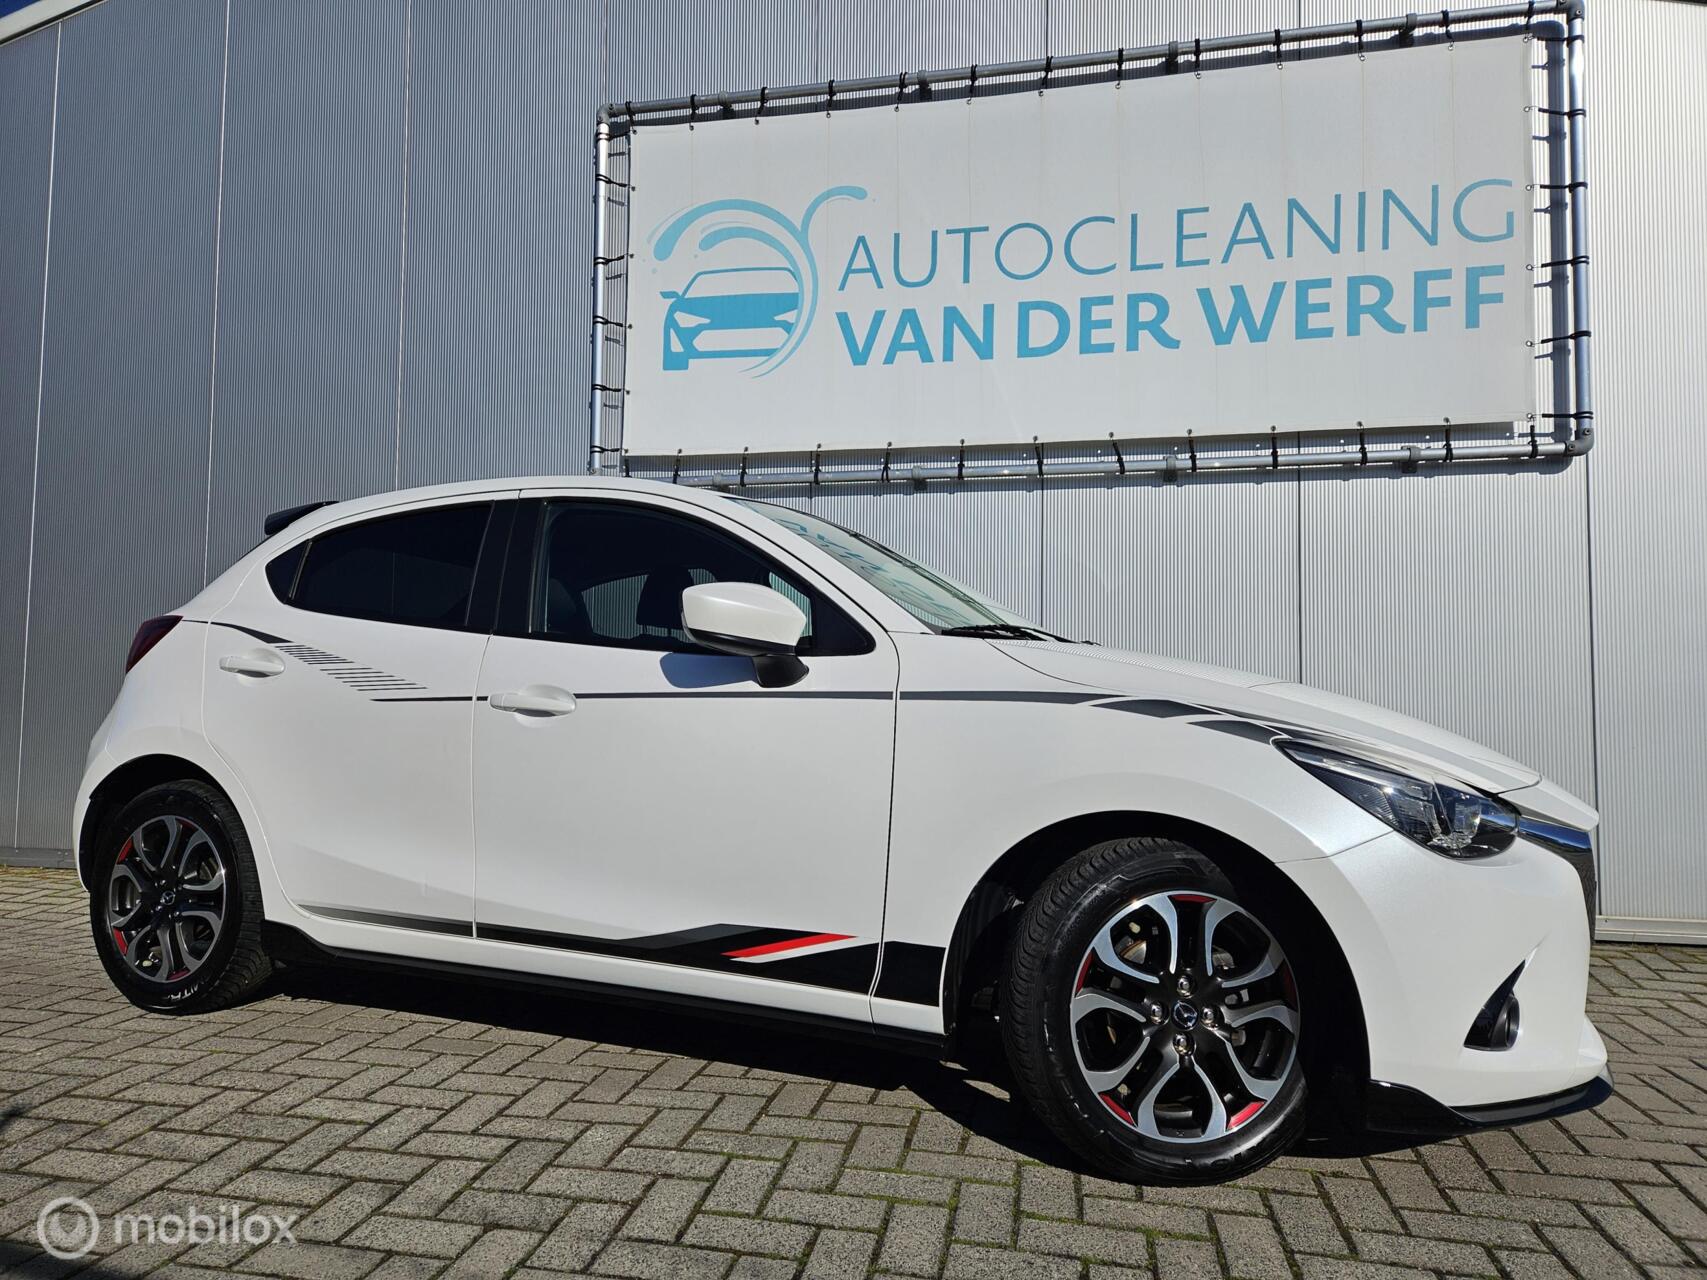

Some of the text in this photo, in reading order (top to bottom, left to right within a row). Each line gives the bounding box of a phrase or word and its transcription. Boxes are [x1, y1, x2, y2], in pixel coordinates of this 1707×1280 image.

[836, 178, 1515, 294] AUTOCLEANING
[834, 263, 1505, 368] VAN DER WERFF
